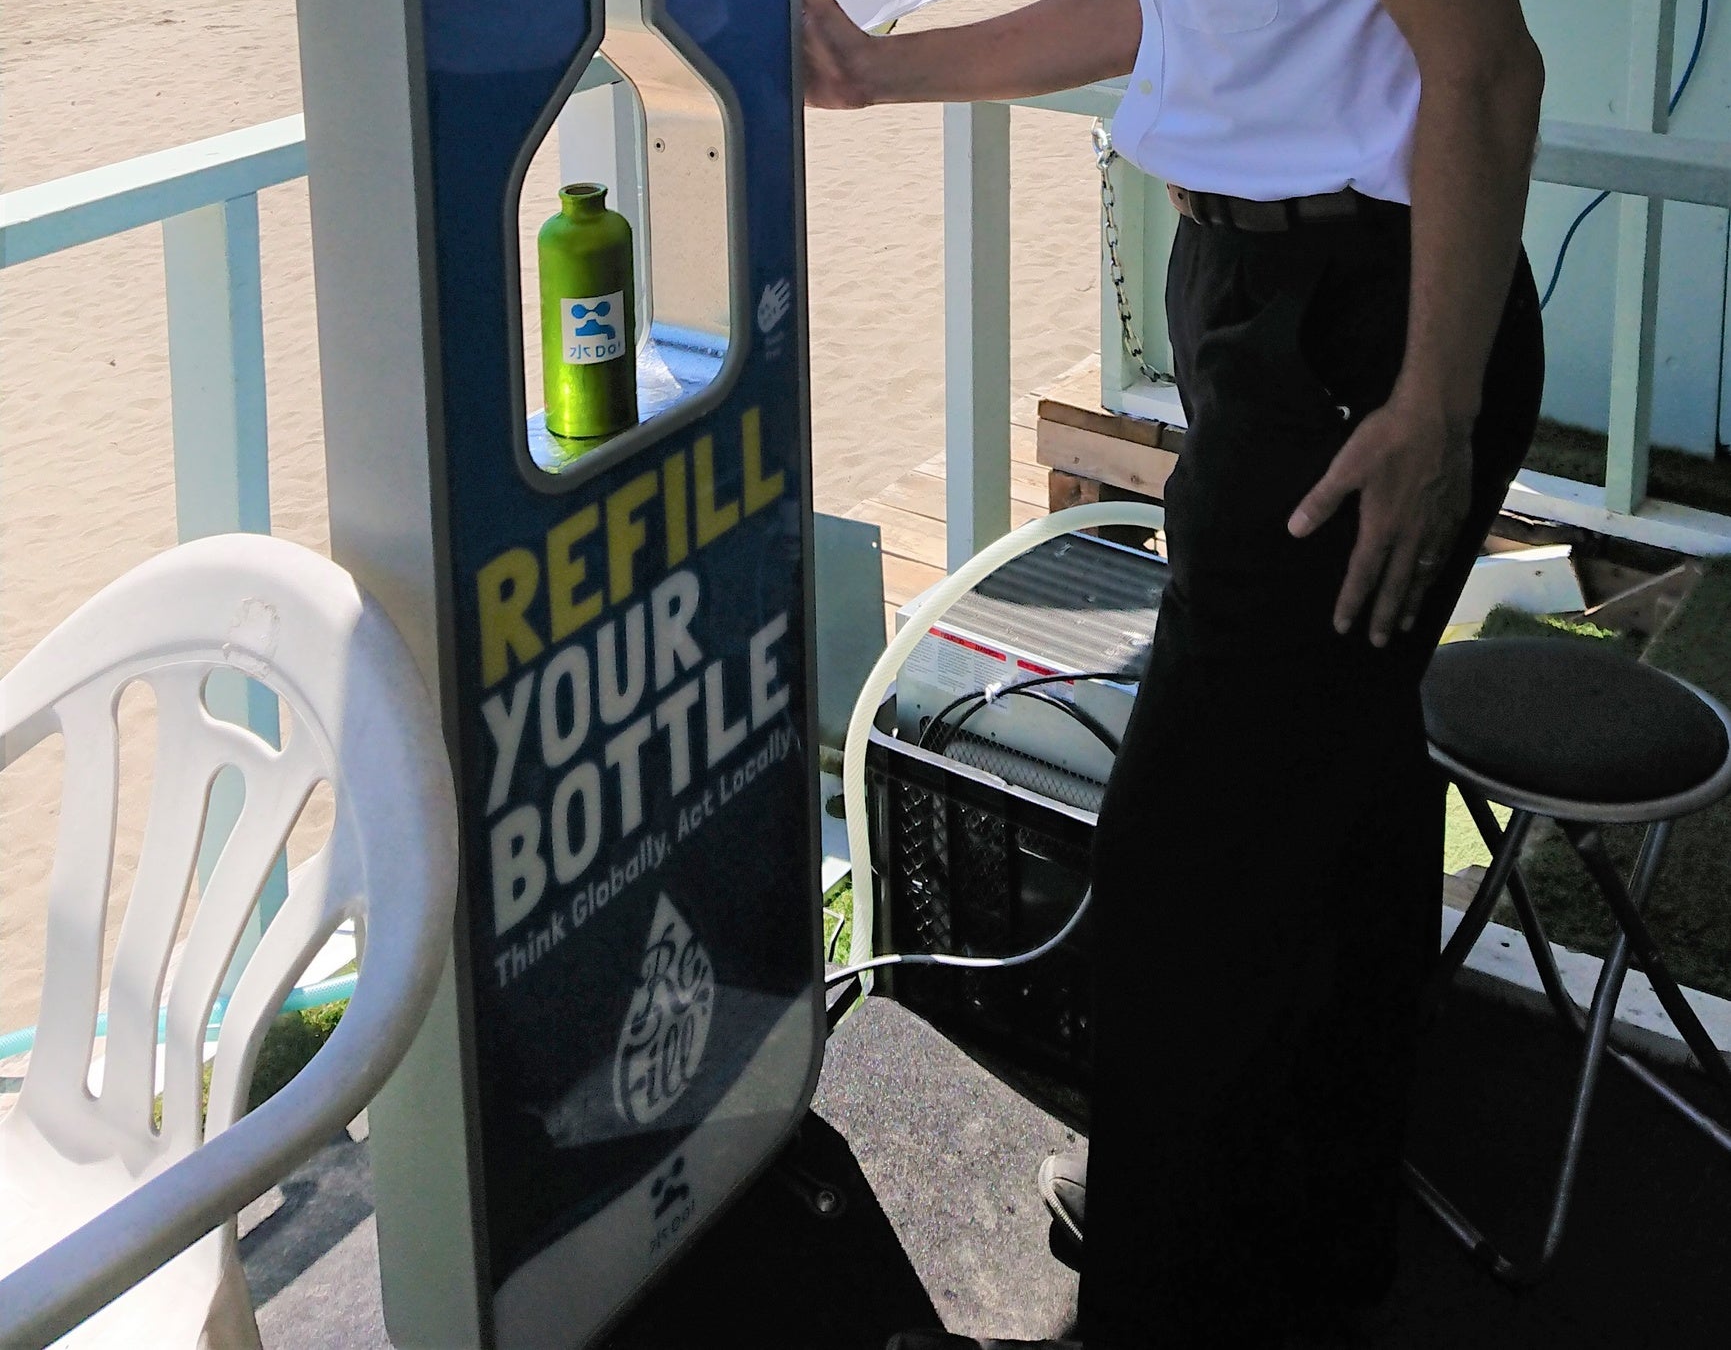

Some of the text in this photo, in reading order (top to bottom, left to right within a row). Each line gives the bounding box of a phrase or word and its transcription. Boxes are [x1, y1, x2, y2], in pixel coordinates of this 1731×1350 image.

[476, 407, 785, 689] REFILL
[481, 570, 702, 817] YOUR
[490, 610, 790, 937] BOTTLE
[495, 912, 567, 988] Think
[677, 790, 714, 842] Act
